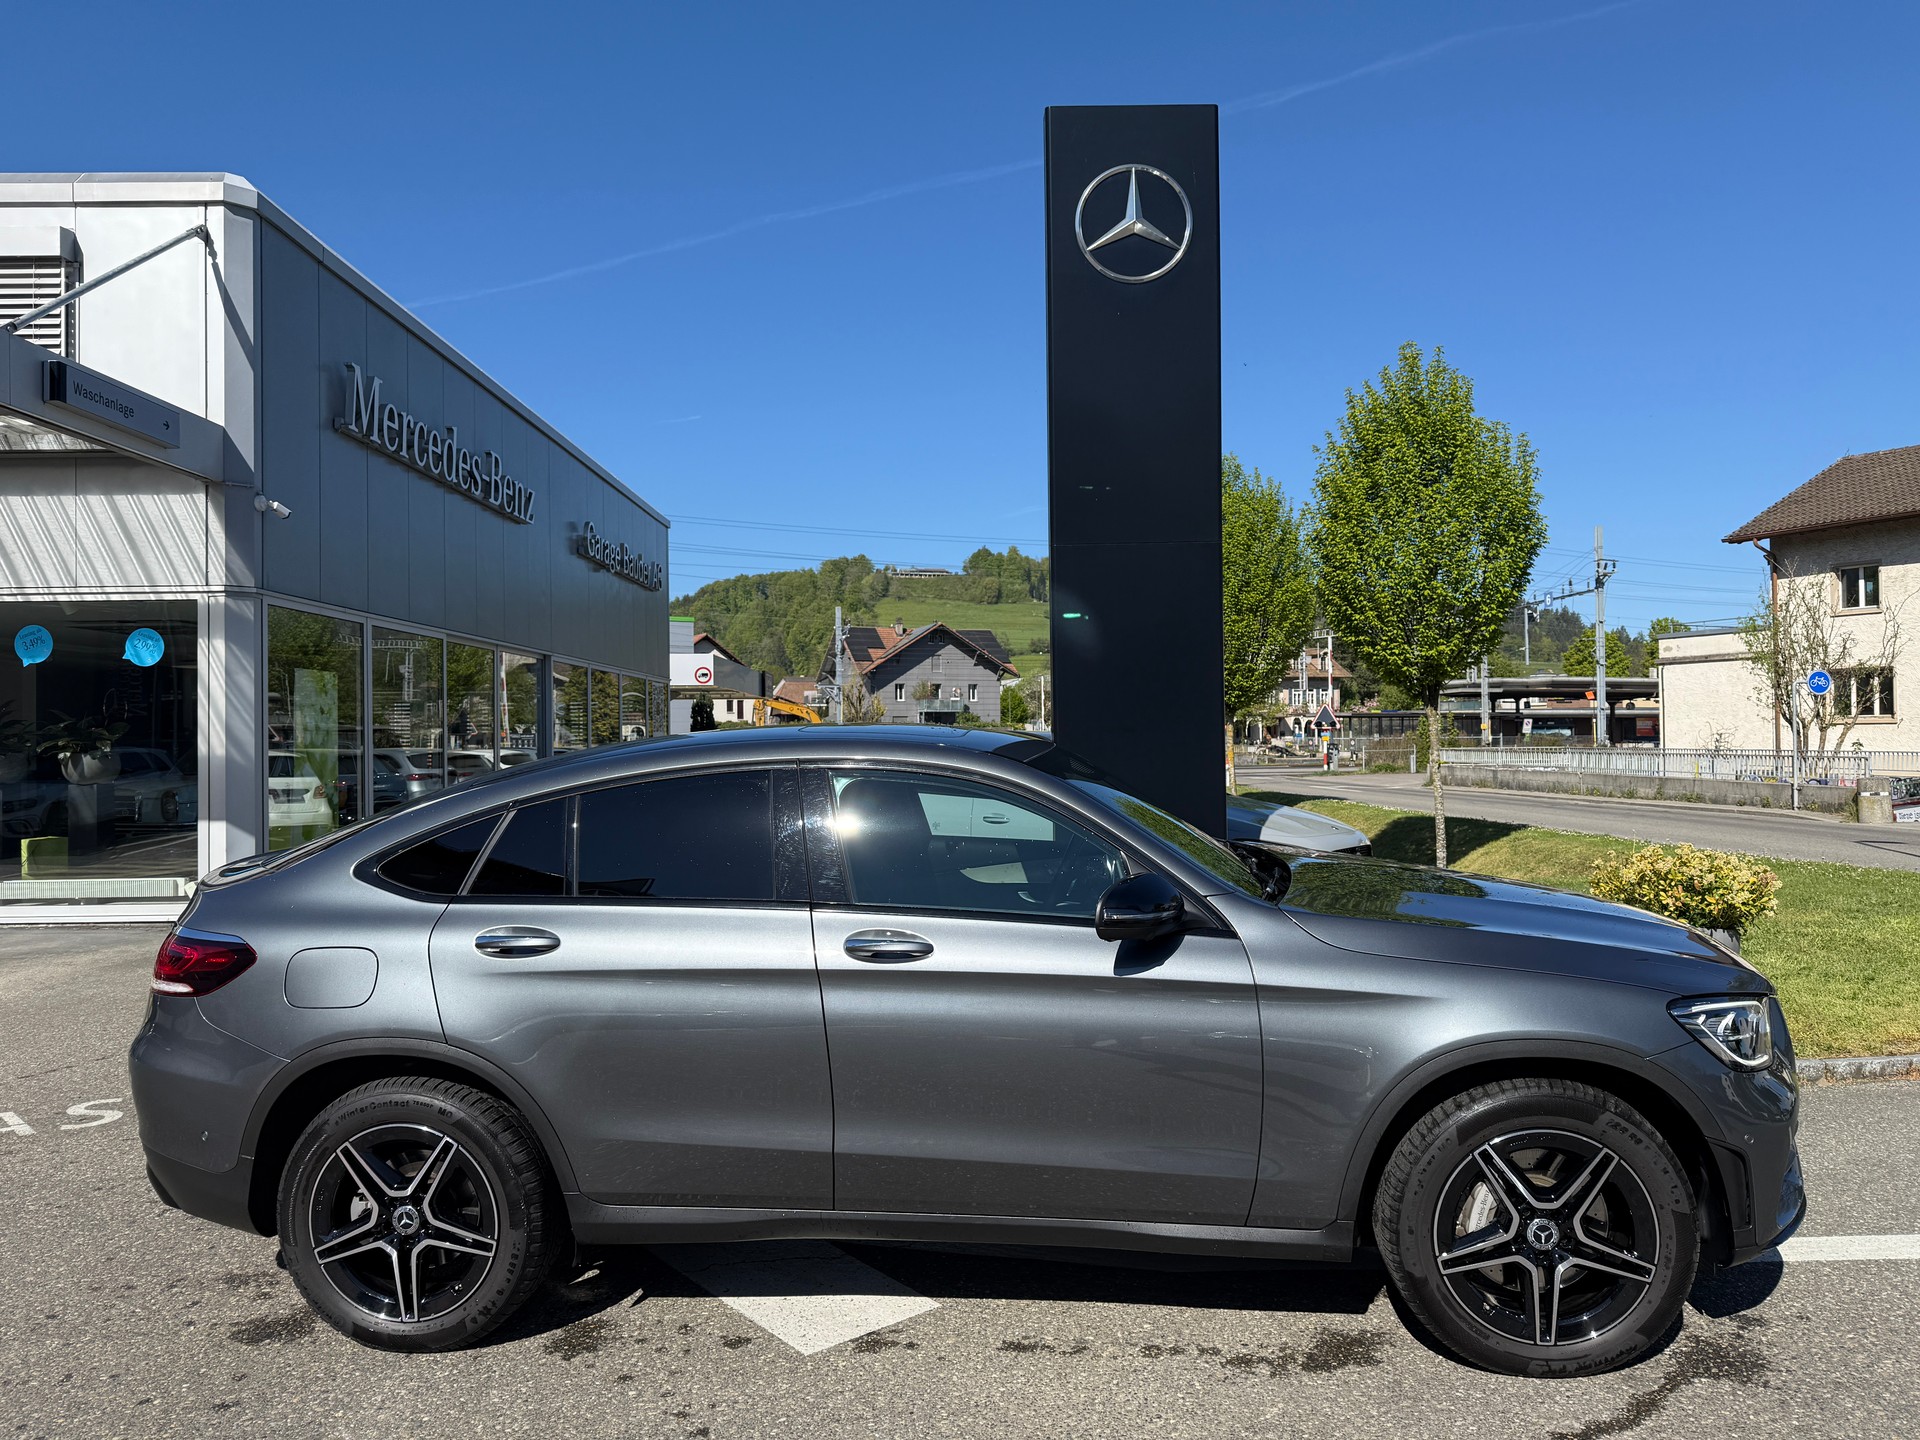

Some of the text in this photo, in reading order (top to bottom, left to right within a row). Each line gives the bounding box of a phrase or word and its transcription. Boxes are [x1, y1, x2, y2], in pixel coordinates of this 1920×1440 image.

[73, 380, 135, 419] Waschanlage
[347, 361, 536, 525] Mercedes-Benz
[587, 521, 621, 573] Garage
[21, 635, 46, 651] 3.49%
[133, 638, 158, 655] 2.99%
